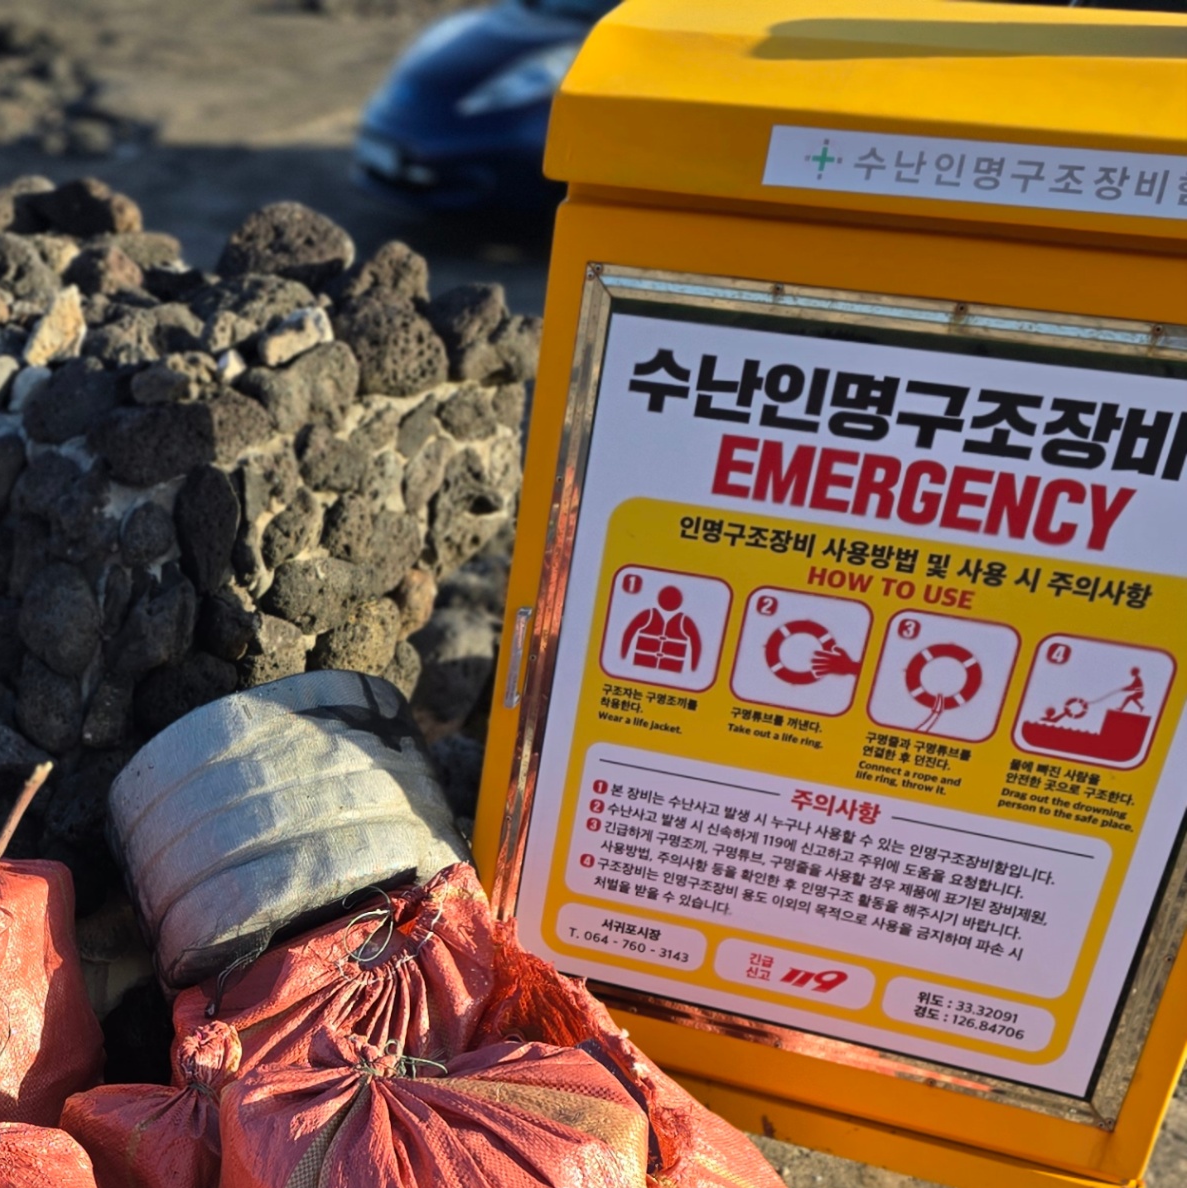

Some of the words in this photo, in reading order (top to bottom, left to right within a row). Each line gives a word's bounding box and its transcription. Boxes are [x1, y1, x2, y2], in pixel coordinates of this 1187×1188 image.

[628, 348, 1187, 481] 수난인명구조장비
[711, 434, 1137, 551] EMERGENCY
[678, 515, 817, 559] 인명구조장비
[822, 537, 919, 574] 사용방법
[925, 553, 951, 579] 및
[956, 557, 1008, 587] 사용
[1013, 566, 1041, 592] 시
[1046, 570, 1153, 611] 주의사항
[807, 565, 874, 593] HOW
[881, 577, 917, 601] TO
[922, 583, 975, 610] USE
[602, 683, 643, 700] 구조자는
[598, 711, 623, 723] Wear
[625, 717, 631, 725] a
[633, 717, 649, 729] life
[650, 720, 682, 735] jacket.
[728, 723, 750, 737] Take
[753, 729, 772, 741] out
[773, 732, 780, 741] a
[781, 732, 798, 744] life
[800, 736, 823, 749] ring.
[787, 717, 823, 733] 꺼낸다.
[858, 760, 902, 777] Connect
[903, 769, 911, 779] a
[913, 772, 938, 786] rope
[940, 775, 961, 787] and
[898, 752, 911, 764] 후
[855, 770, 872, 781] life
[875, 773, 898, 788] ring,
[901, 779, 934, 793] throw
[935, 785, 946, 796] it.
[1005, 771, 1042, 788] 안전한
[1043, 779, 1080, 796] 곳으로
[1083, 787, 1135, 807] 구조한다.
[1064, 768, 1101, 785] 사람을
[791, 788, 881, 825] 주의사항
[997, 799, 1034, 815] person
[1037, 806, 1051, 816] to
[1054, 807, 1072, 820] the
[1074, 811, 1098, 825] safe
[1100, 816, 1134, 833] place.
[1001, 787, 1027, 802] Drag
[1029, 793, 1050, 804] out
[1051, 795, 1070, 808] the
[1072, 800, 1127, 820] drowning
[607, 803, 657, 823] 수난사고
[661, 813, 687, 830] 발생
[690, 819, 703, 833] 시
[707, 822, 759, 844] 신속하게
[762, 833, 797, 852] 119에
[801, 842, 854, 864] 신고하고
[858, 853, 900, 874] 주위에
[903, 862, 946, 884] 도움을
[948, 871, 1023, 900] 요청합니다.
[611, 784, 623, 797] 본
[627, 787, 665, 805] 장비는
[668, 794, 719, 816] 수난사고
[724, 806, 751, 822] 발생
[754, 811, 767, 827] 시
[770, 815, 811, 835] 누구나
[814, 824, 856, 843] 사용할
[859, 834, 873, 847] 수
[877, 838, 905, 854] 있는
[909, 843, 1055, 886] 인명구조장비함입니다.
[600, 839, 653, 862] 사용방법,
[657, 851, 708, 873] 주의사항
[711, 862, 737, 880] 등을
[741, 867, 780, 888] 확인한
[783, 877, 797, 891] 후
[801, 882, 854, 904] 인명구조
[857, 893, 899, 914] 활동을
[902, 901, 959, 927] 해주시기
[962, 913, 1022, 940] 바랍니다.
[604, 820, 653, 843] 긴급하게
[655, 832, 708, 854] 구명조끼,
[712, 843, 765, 866] 구명튜브,
[769, 854, 822, 878] 구명줄을
[824, 867, 866, 887] 사용할
[869, 875, 896, 893] 경우
[898, 881, 941, 903] 제품에
[943, 891, 986, 912] 표기된
[988, 900, 1048, 927] 장비제원,
[594, 875, 631, 894] 처벌을
[634, 884, 660, 901] 받을
[663, 890, 676, 903] 수
[678, 894, 733, 916] 있습니다.
[598, 857, 659, 880] 구조장비는
[663, 871, 739, 898] 인명구조장비
[741, 887, 768, 904] 용도
[772, 892, 811, 914] 이외의
[814, 901, 868, 926] 목적으로
[871, 915, 914, 937] 사용을
[917, 926, 972, 950] 금지하며
[975, 939, 1004, 957] 파손
[1009, 947, 1023, 961] 시
[569, 926, 579, 939] T.
[584, 931, 609, 946] 064
[622, 938, 647, 953] 760
[658, 947, 690, 963] 3143
[601, 917, 662, 942] 서귀포시장
[745, 966, 771, 982] 신고
[749, 952, 775, 969] 긴급
[780, 966, 848, 993] 119
[913, 1004, 940, 1021] 경도
[952, 1014, 1025, 1040] 126.84706
[917, 991, 944, 1008] 위도
[955, 999, 1019, 1024] 33.32091
